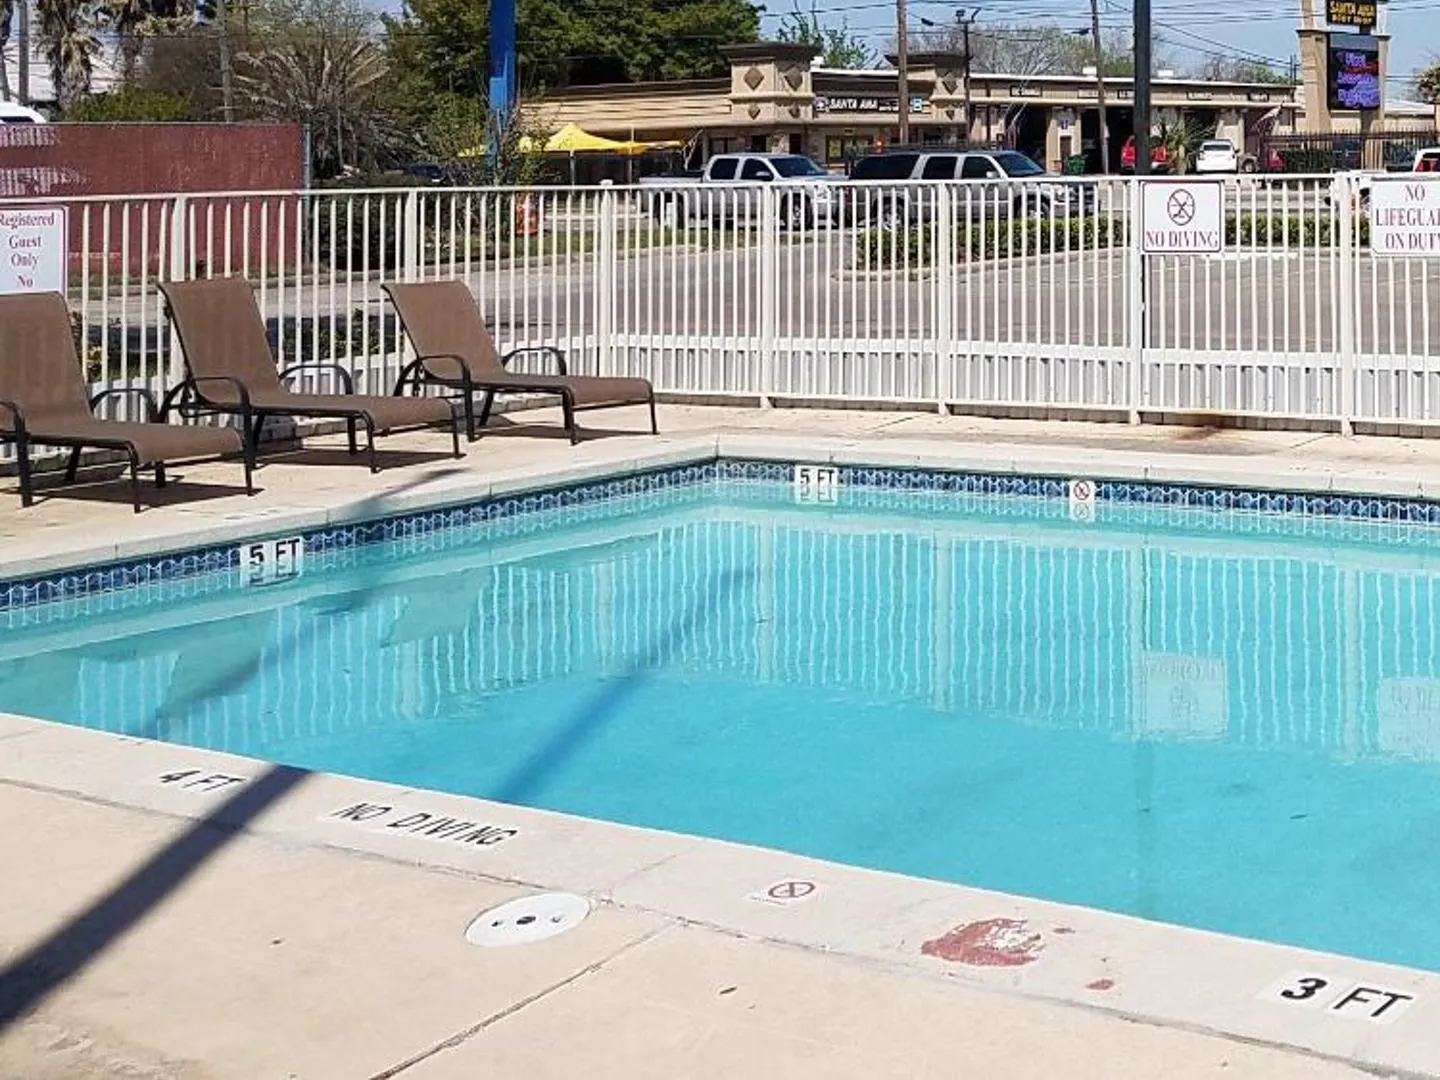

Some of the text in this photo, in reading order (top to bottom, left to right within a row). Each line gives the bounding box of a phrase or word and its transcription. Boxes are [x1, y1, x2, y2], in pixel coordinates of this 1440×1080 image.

[1330, 0, 1356, 15] SANTA
[829, 99, 857, 110] SANTA
[1405, 183, 1426, 202] NO
[9, 235, 42, 250] Guest
[1146, 231, 1218, 248] NO DIVING
[1385, 232, 1404, 250] ON
[10, 252, 39, 271] Only
[18, 274, 34, 288] No
[800, 469, 835, 485] 5 FT
[249, 538, 300, 565] 5 FT
[159, 770, 246, 792] 4 FT
[329, 803, 518, 845] NO DIVING
[1280, 977, 1414, 1018] 3 FT
